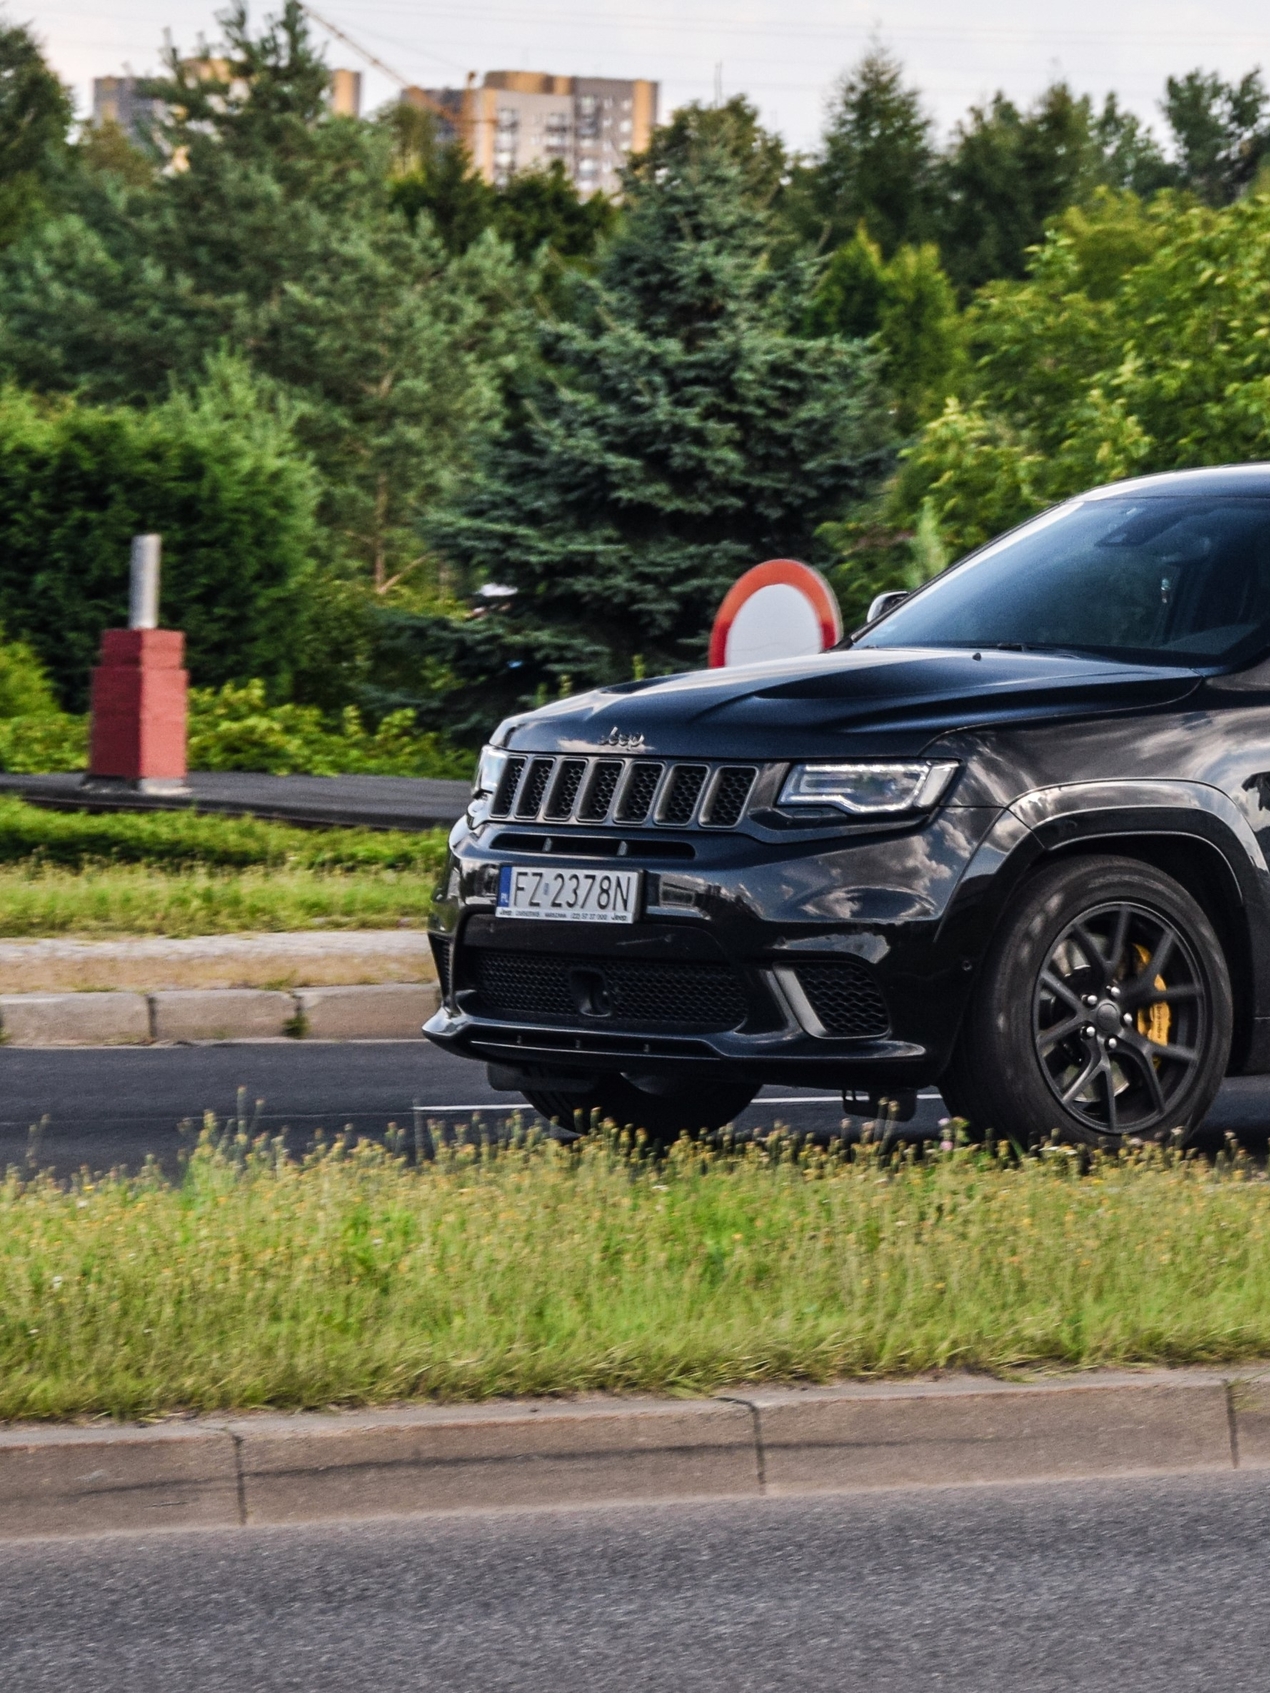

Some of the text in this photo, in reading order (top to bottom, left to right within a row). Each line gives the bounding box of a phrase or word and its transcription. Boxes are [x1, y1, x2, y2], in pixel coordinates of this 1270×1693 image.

[597, 726, 645, 751] Jeep
[514, 872, 631, 912] FZ 2378N
